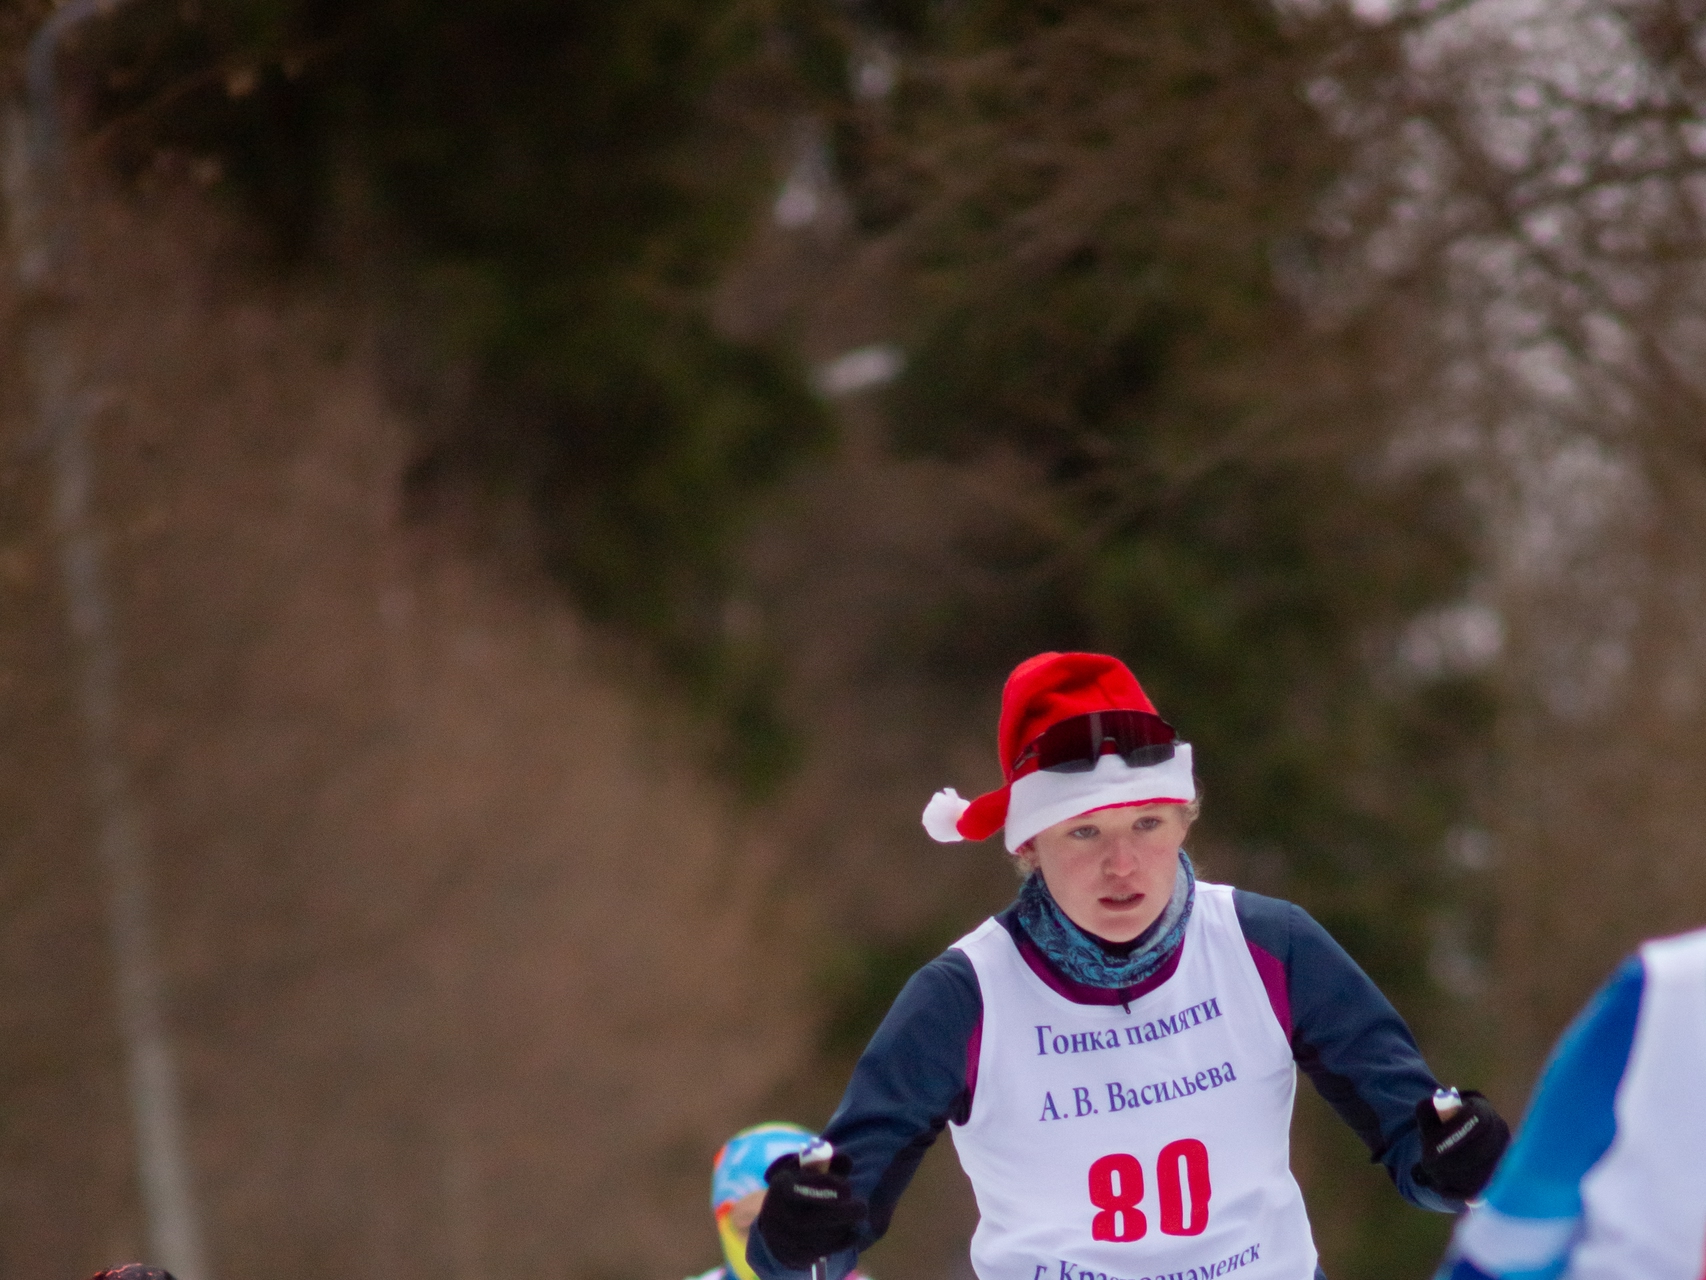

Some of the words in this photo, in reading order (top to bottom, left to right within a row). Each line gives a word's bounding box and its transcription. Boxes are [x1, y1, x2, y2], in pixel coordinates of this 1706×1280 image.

[1033, 1024, 1121, 1056] Гонка
[1124, 997, 1223, 1046] памяти
[1105, 1061, 1237, 1113] Васильева
[1087, 1137, 1212, 1243] 80
